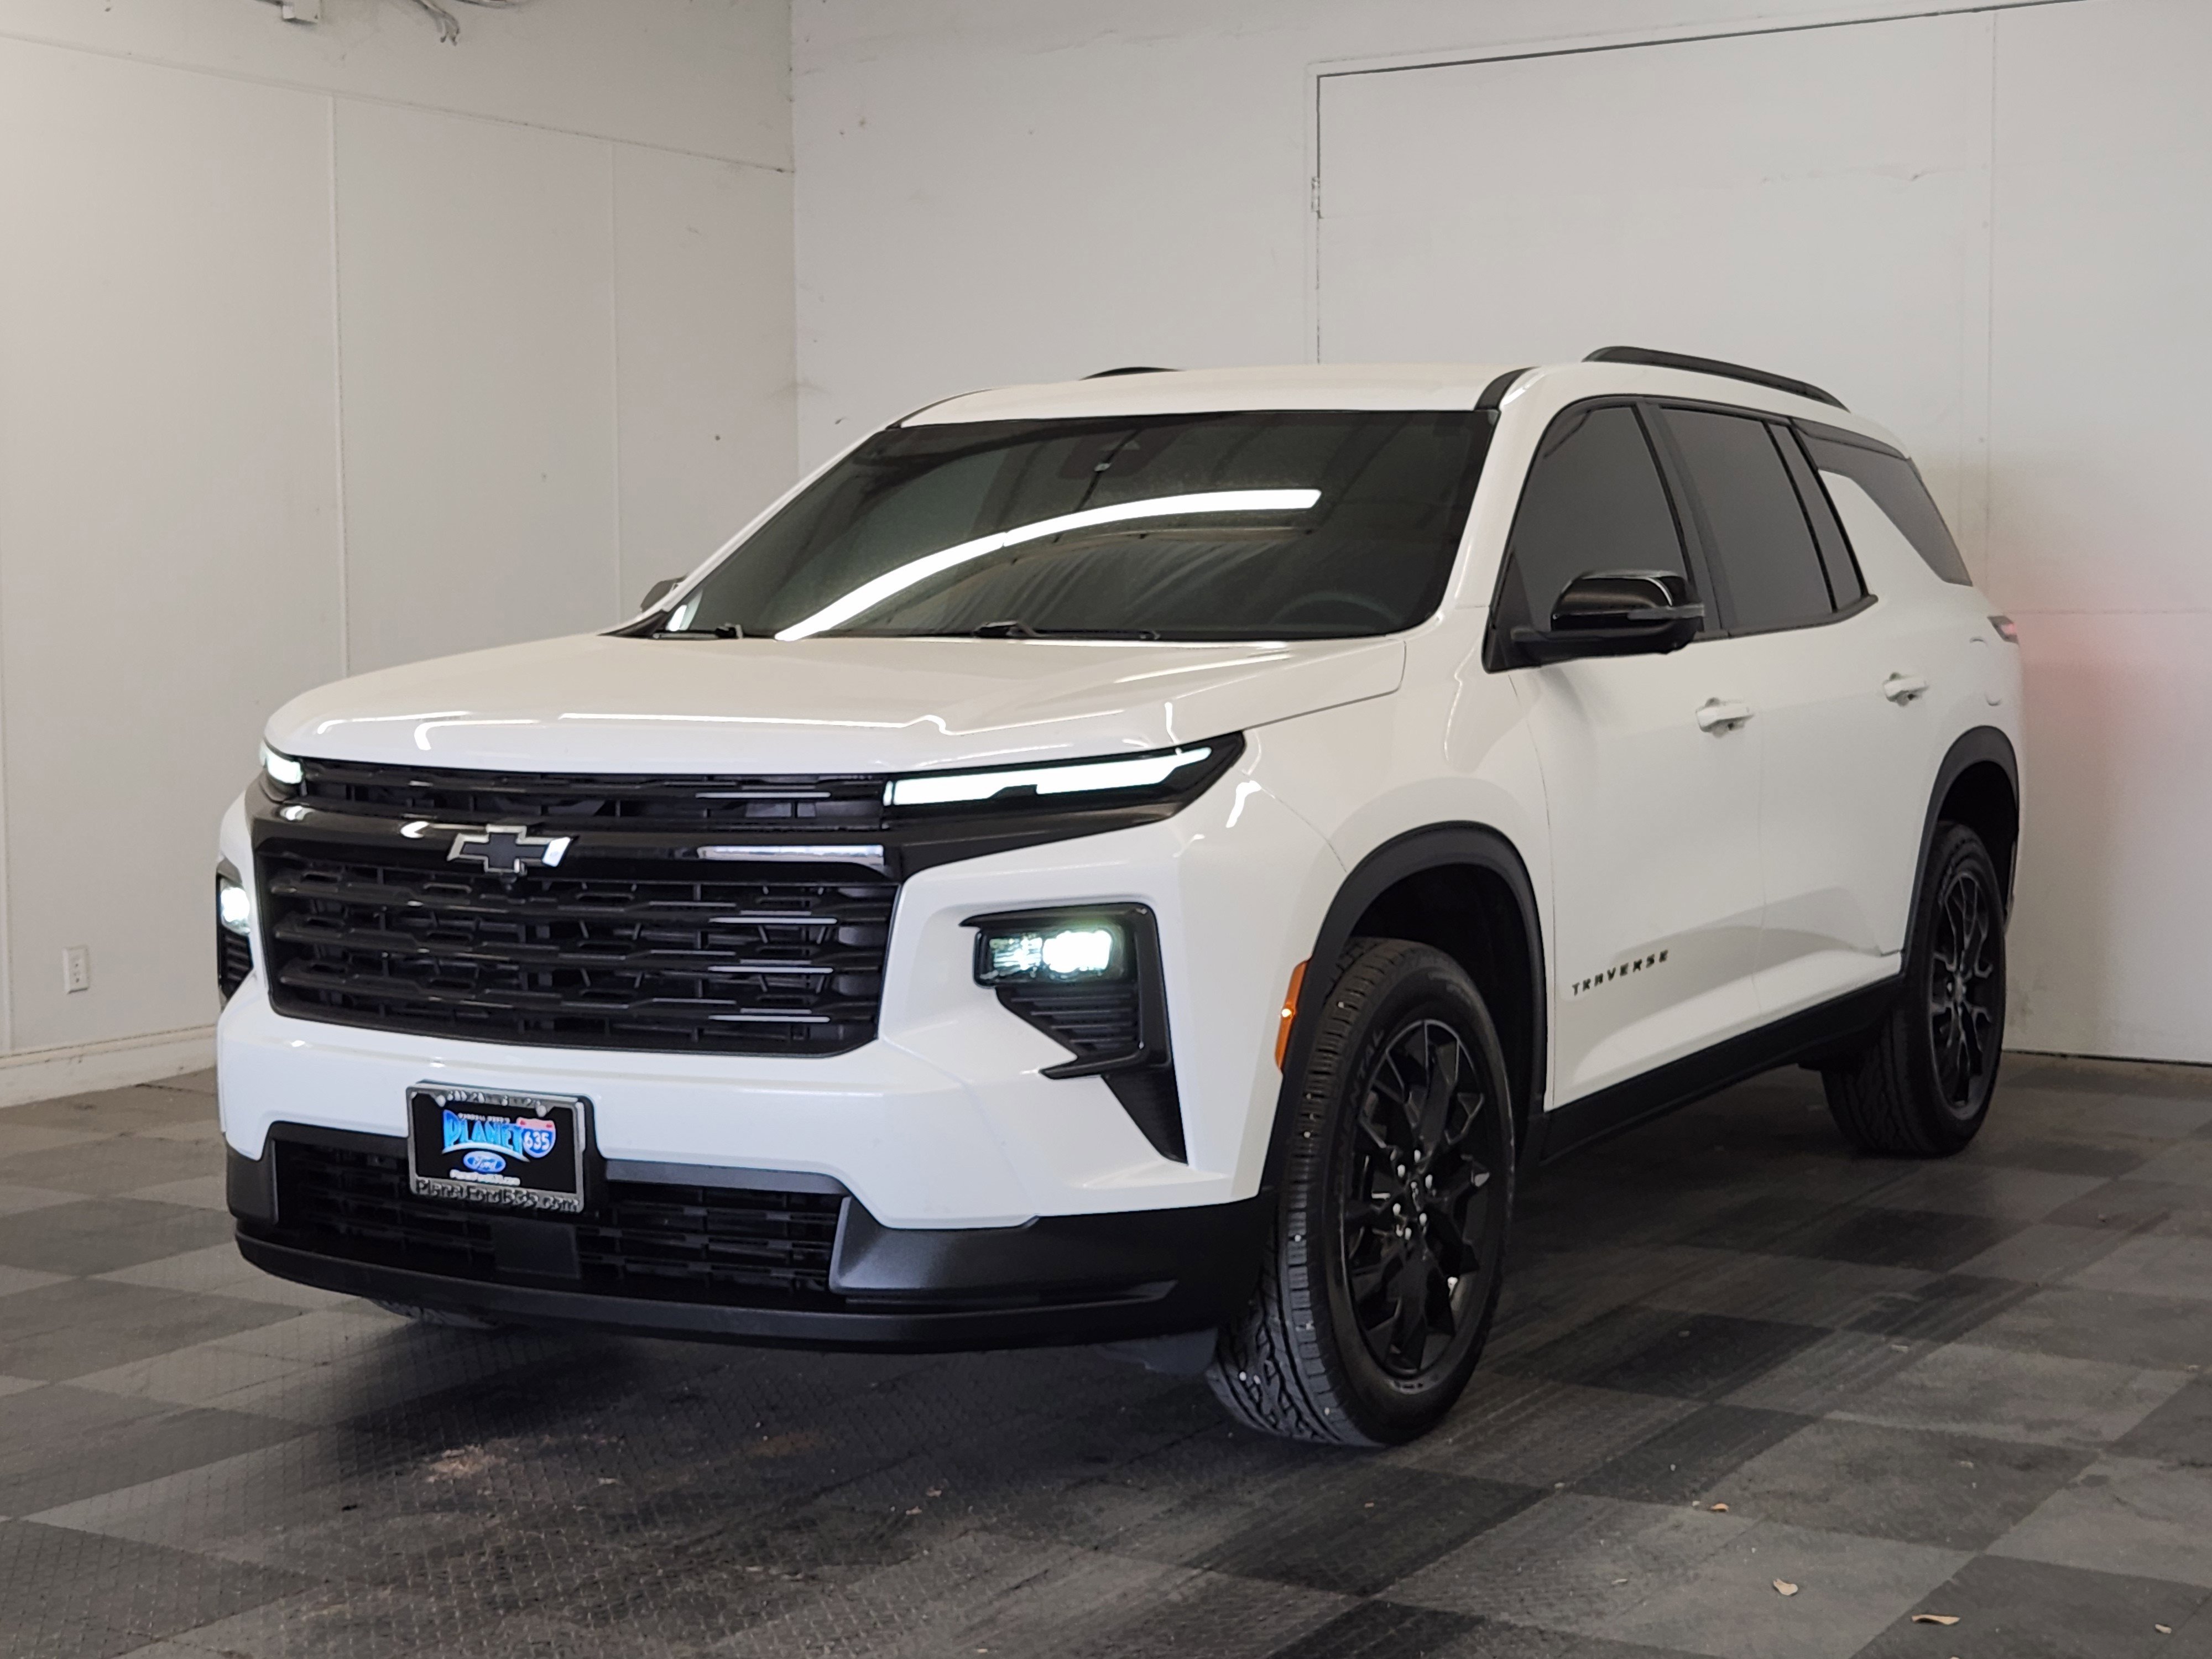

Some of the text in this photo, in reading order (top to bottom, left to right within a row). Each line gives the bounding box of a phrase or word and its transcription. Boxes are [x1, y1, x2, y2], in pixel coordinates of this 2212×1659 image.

[1572, 949, 1668, 996] TRAVERSE
[444, 1110, 550, 1155] PLANET 635
[472, 1156, 498, 1170] Ford
